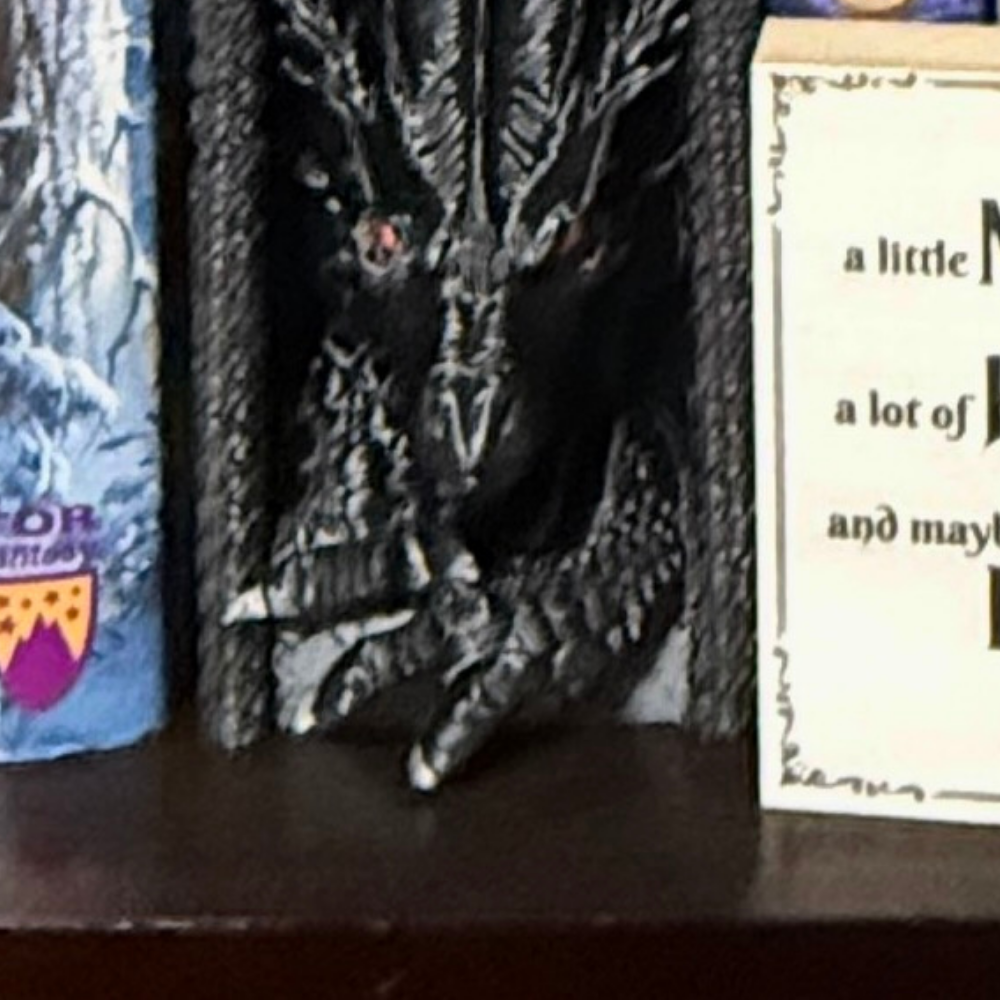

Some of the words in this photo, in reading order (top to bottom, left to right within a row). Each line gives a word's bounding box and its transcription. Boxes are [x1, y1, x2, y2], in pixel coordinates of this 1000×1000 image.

[845, 249, 864, 273] a
[878, 237, 968, 278] little
[834, 400, 856, 425] a
[869, 389, 919, 428] lot
[930, 395, 971, 441] of
[0, 504, 100, 537] OR
[827, 505, 898, 544] and
